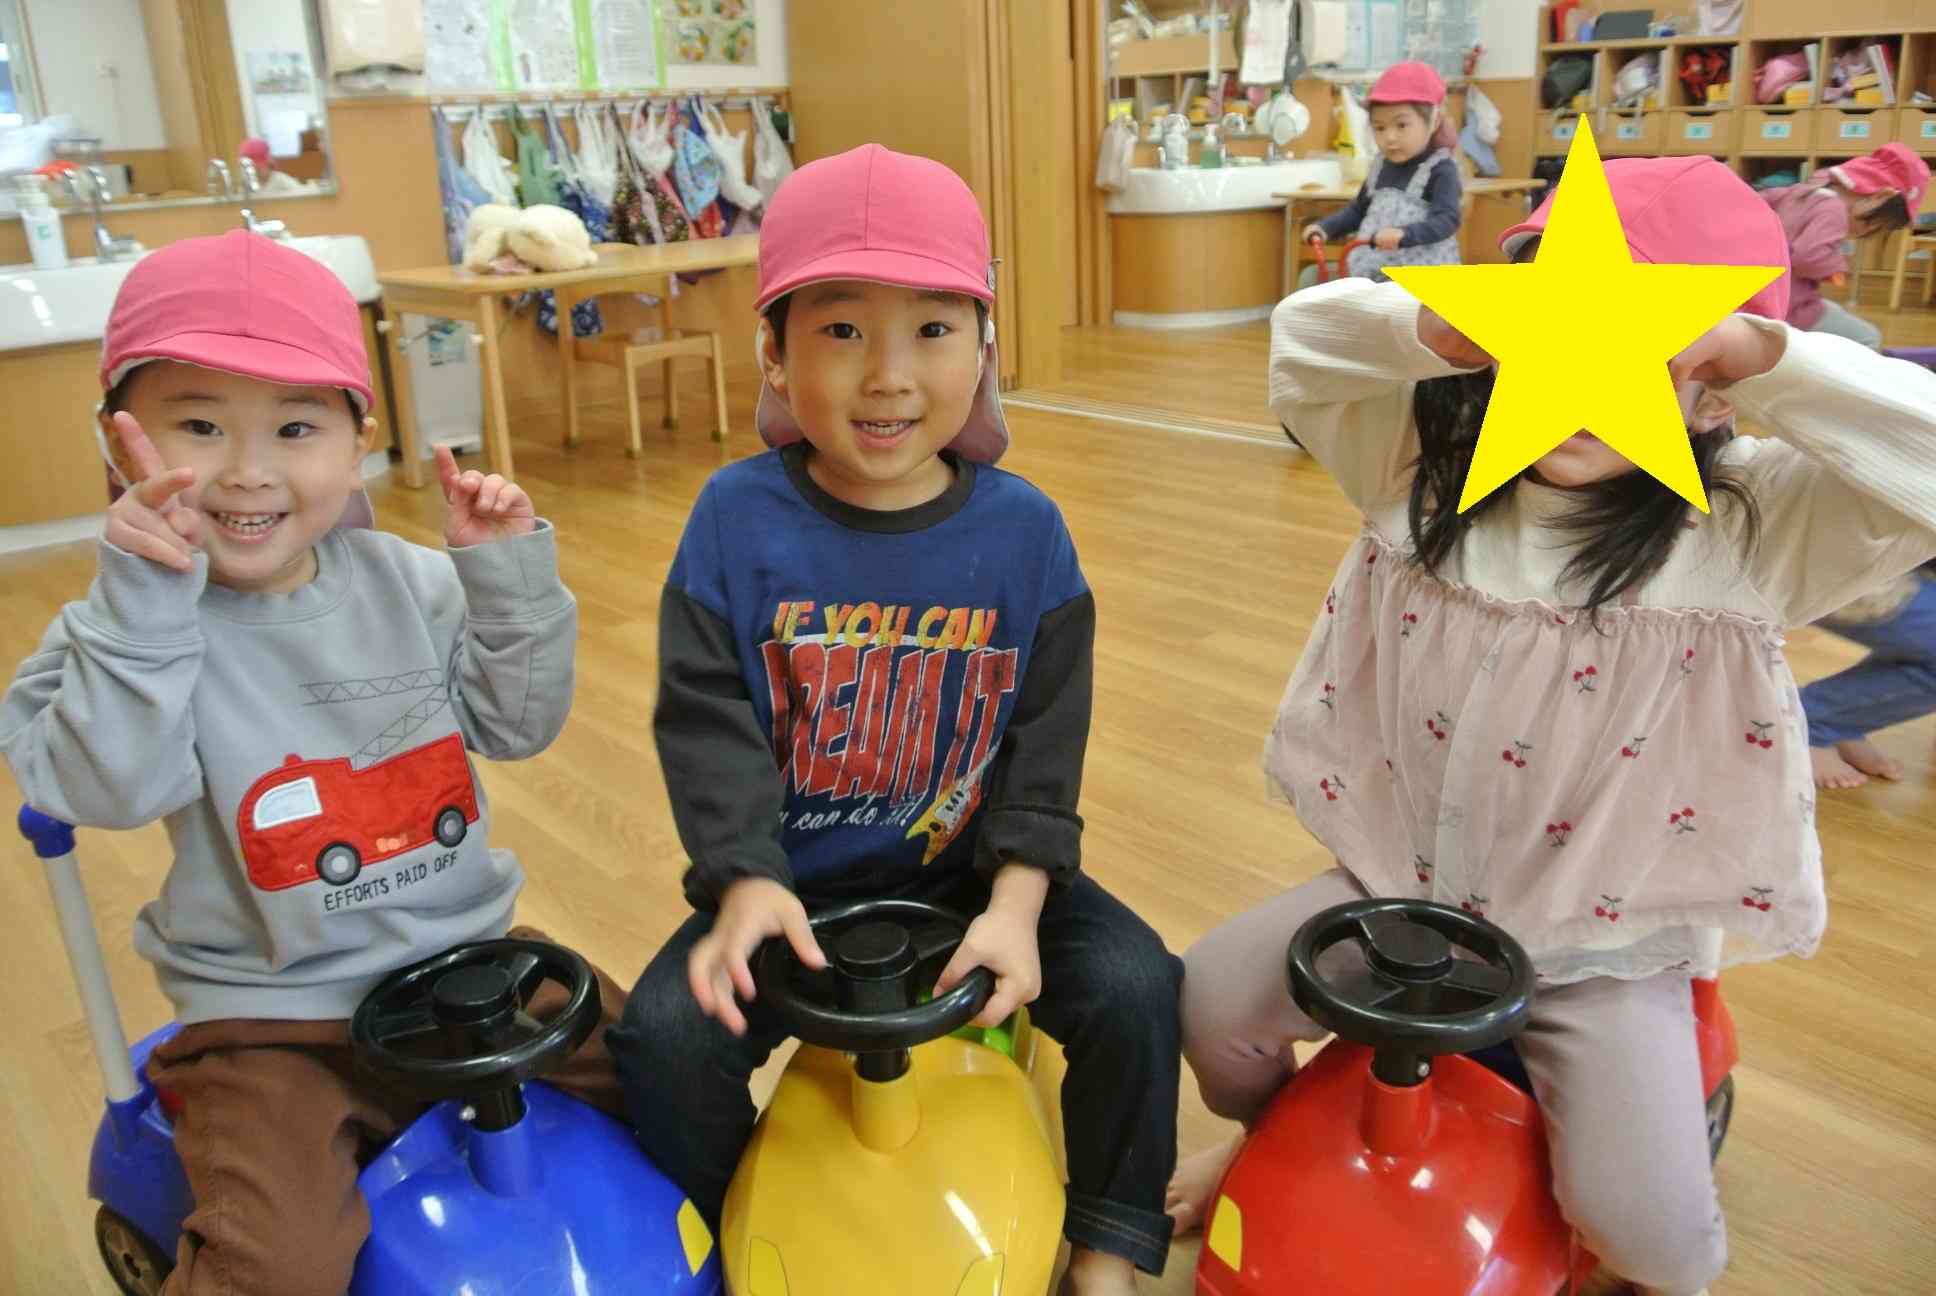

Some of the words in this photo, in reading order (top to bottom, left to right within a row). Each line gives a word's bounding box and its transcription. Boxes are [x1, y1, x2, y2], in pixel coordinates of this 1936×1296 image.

[773, 601, 816, 643] IF
[824, 601, 912, 648] YOU
[917, 606, 998, 651] CAN
[936, 647, 1019, 801] IT
[792, 810, 841, 830] can
[842, 792, 878, 826] do
[323, 877, 390, 912] EFFORTS
[396, 863, 428, 889] PAID
[434, 850, 460, 873] OFF
